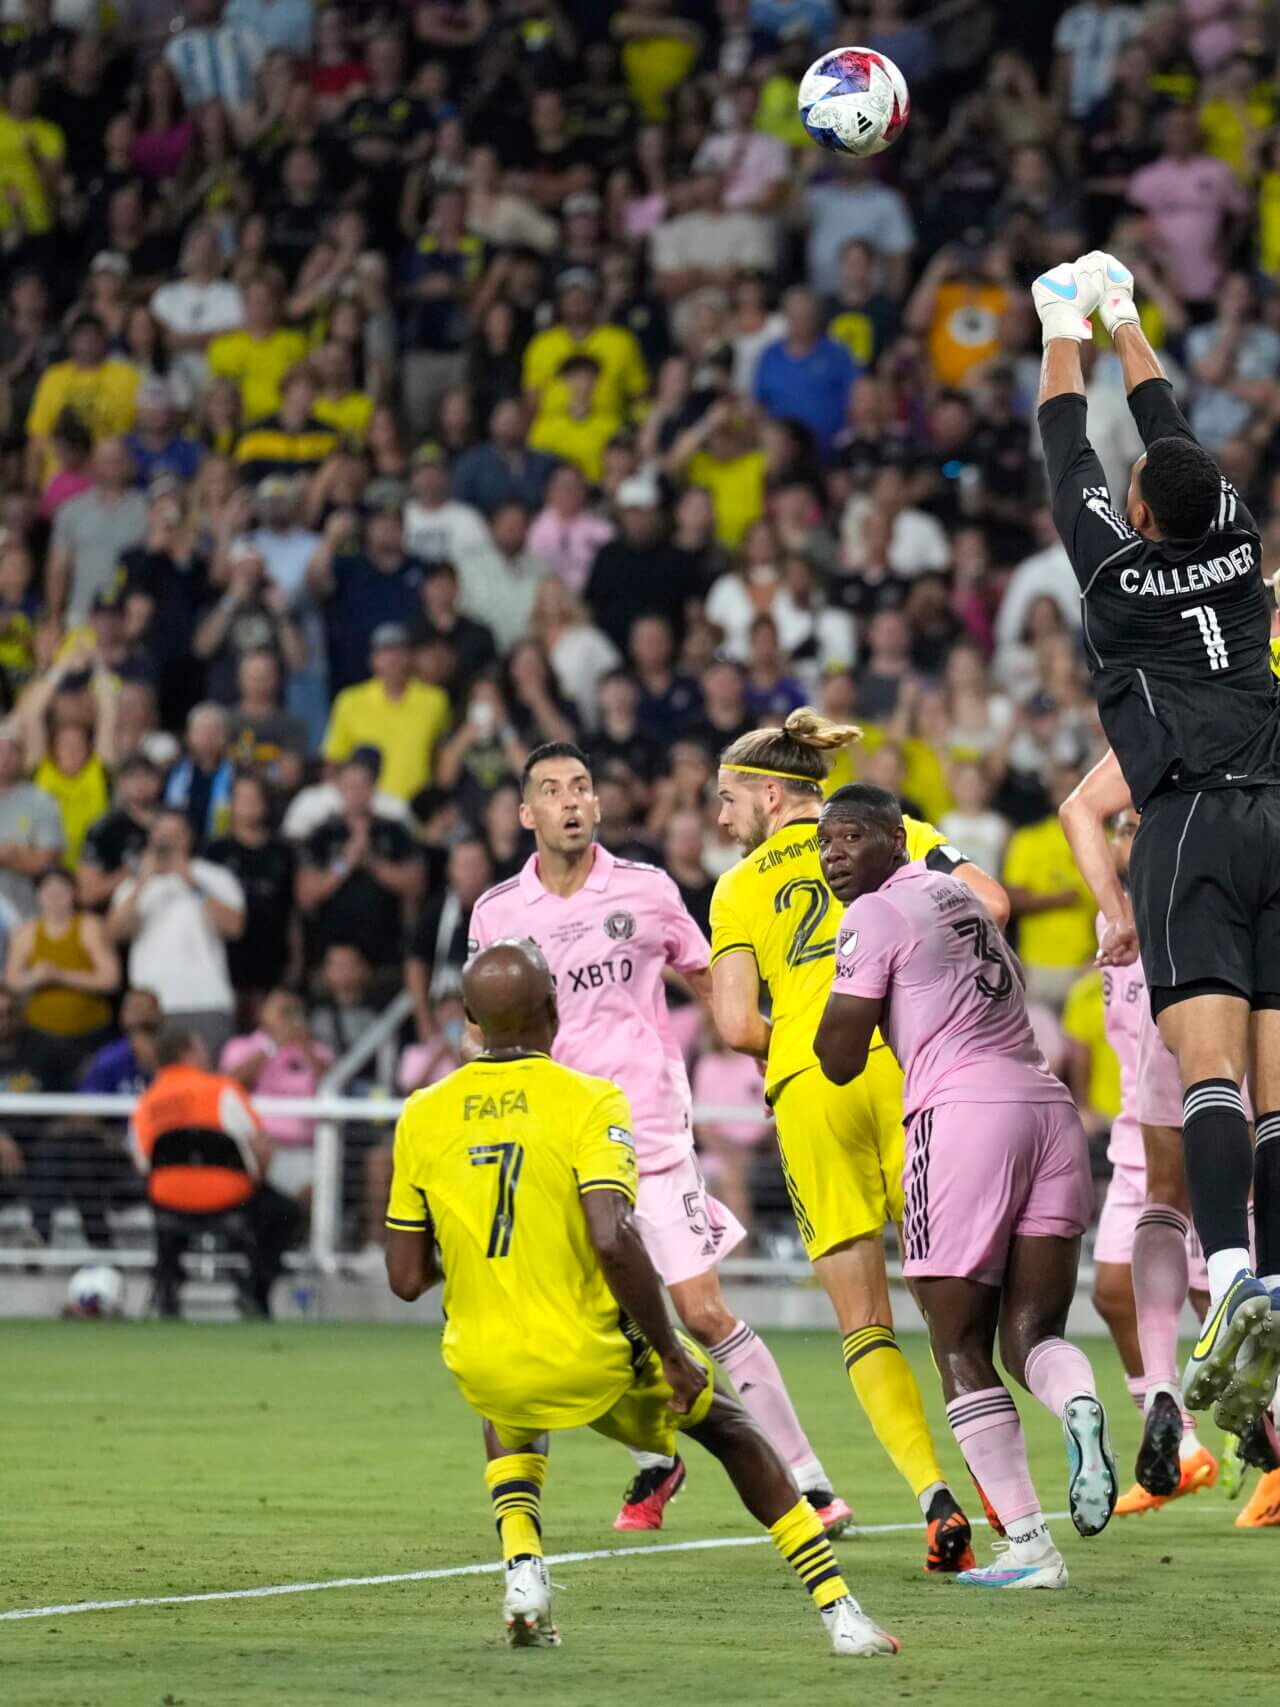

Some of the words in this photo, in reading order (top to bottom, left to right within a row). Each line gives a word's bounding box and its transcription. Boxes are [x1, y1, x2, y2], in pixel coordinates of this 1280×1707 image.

[1120, 543, 1255, 597] CALLENDER
[1181, 605, 1230, 670] 1
[567, 958, 633, 993] XBTO
[464, 1090, 529, 1121] FAFA
[467, 1142, 525, 1258] 7
